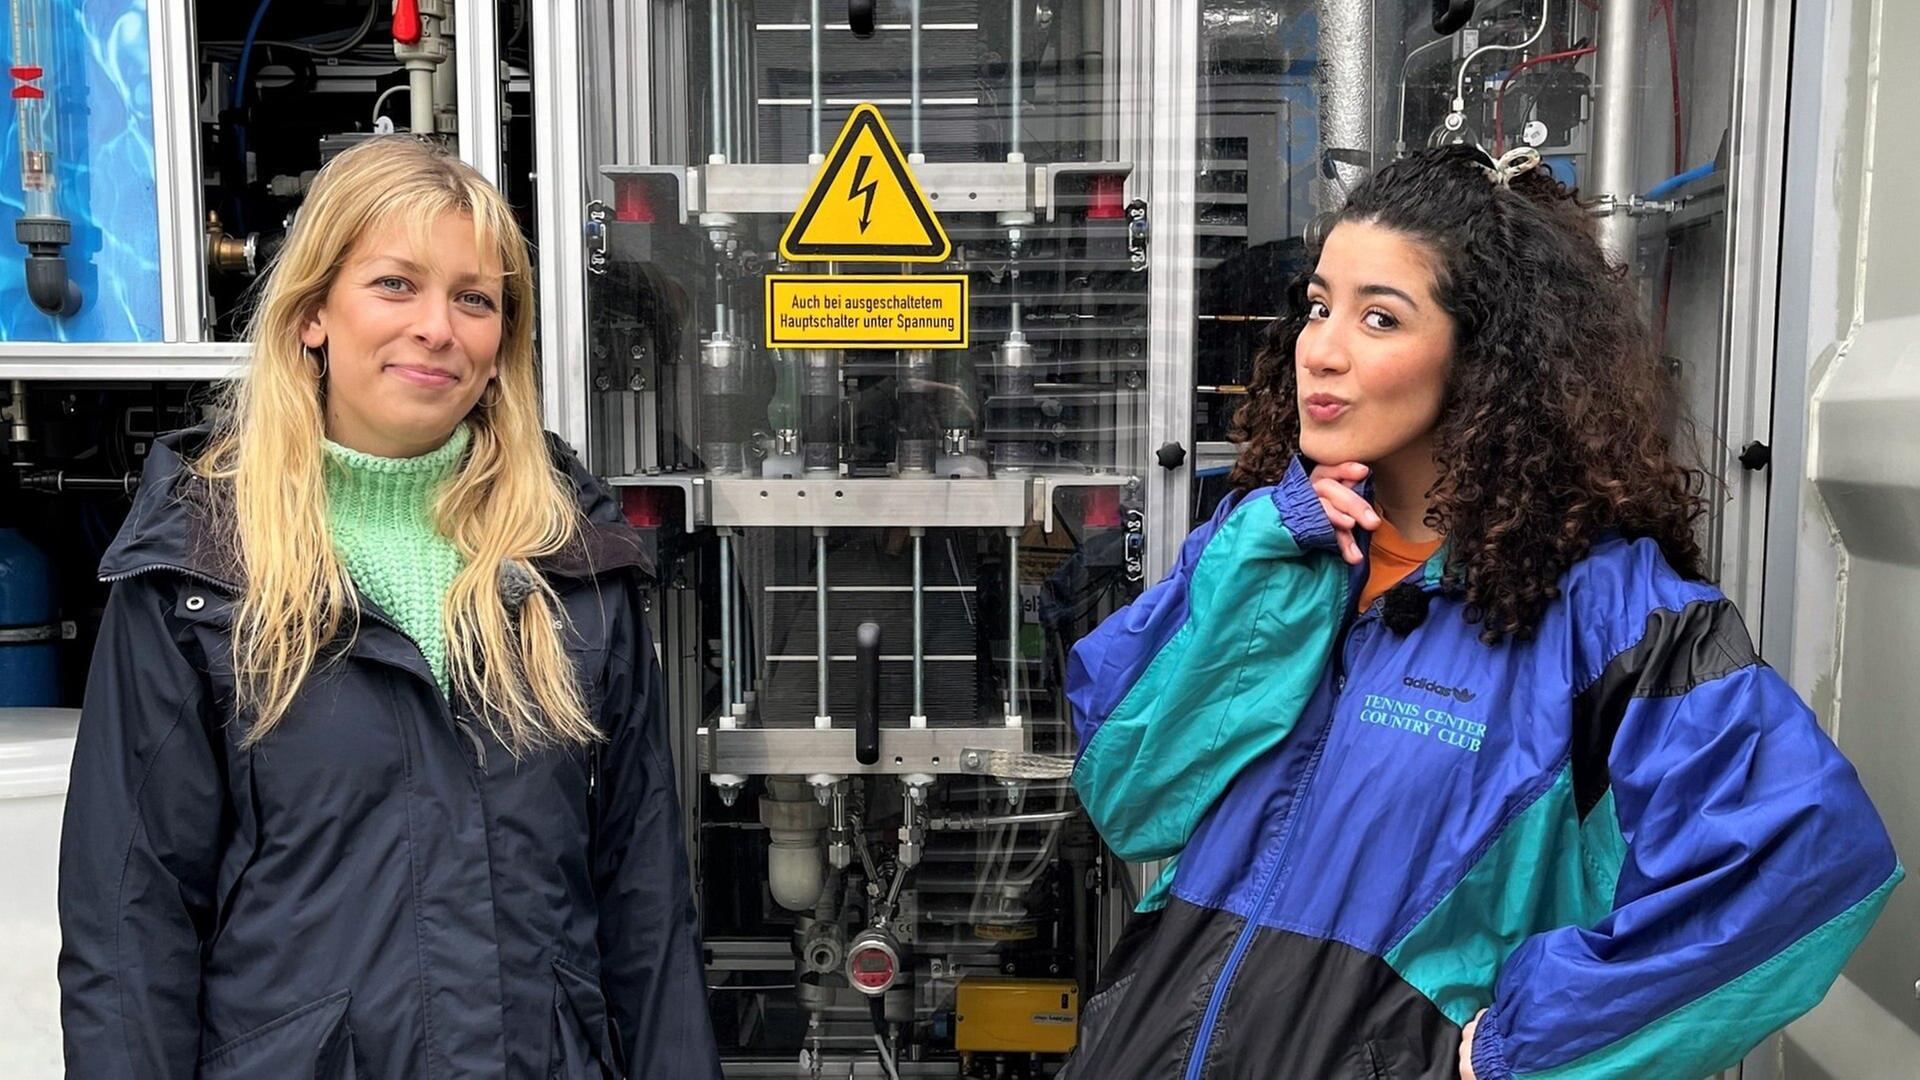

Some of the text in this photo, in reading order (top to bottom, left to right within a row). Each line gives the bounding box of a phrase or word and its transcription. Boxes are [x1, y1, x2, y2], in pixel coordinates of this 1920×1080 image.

[792, 294, 942, 312] Auch bei ausgeschaltetem
[780, 314, 954, 332] Hauptschalter unter Spannung
[1403, 677, 1451, 697] adidas
[1365, 695, 1487, 737] TENNIS CENTER
[1360, 709, 1482, 753] COUNTRY CLUB
